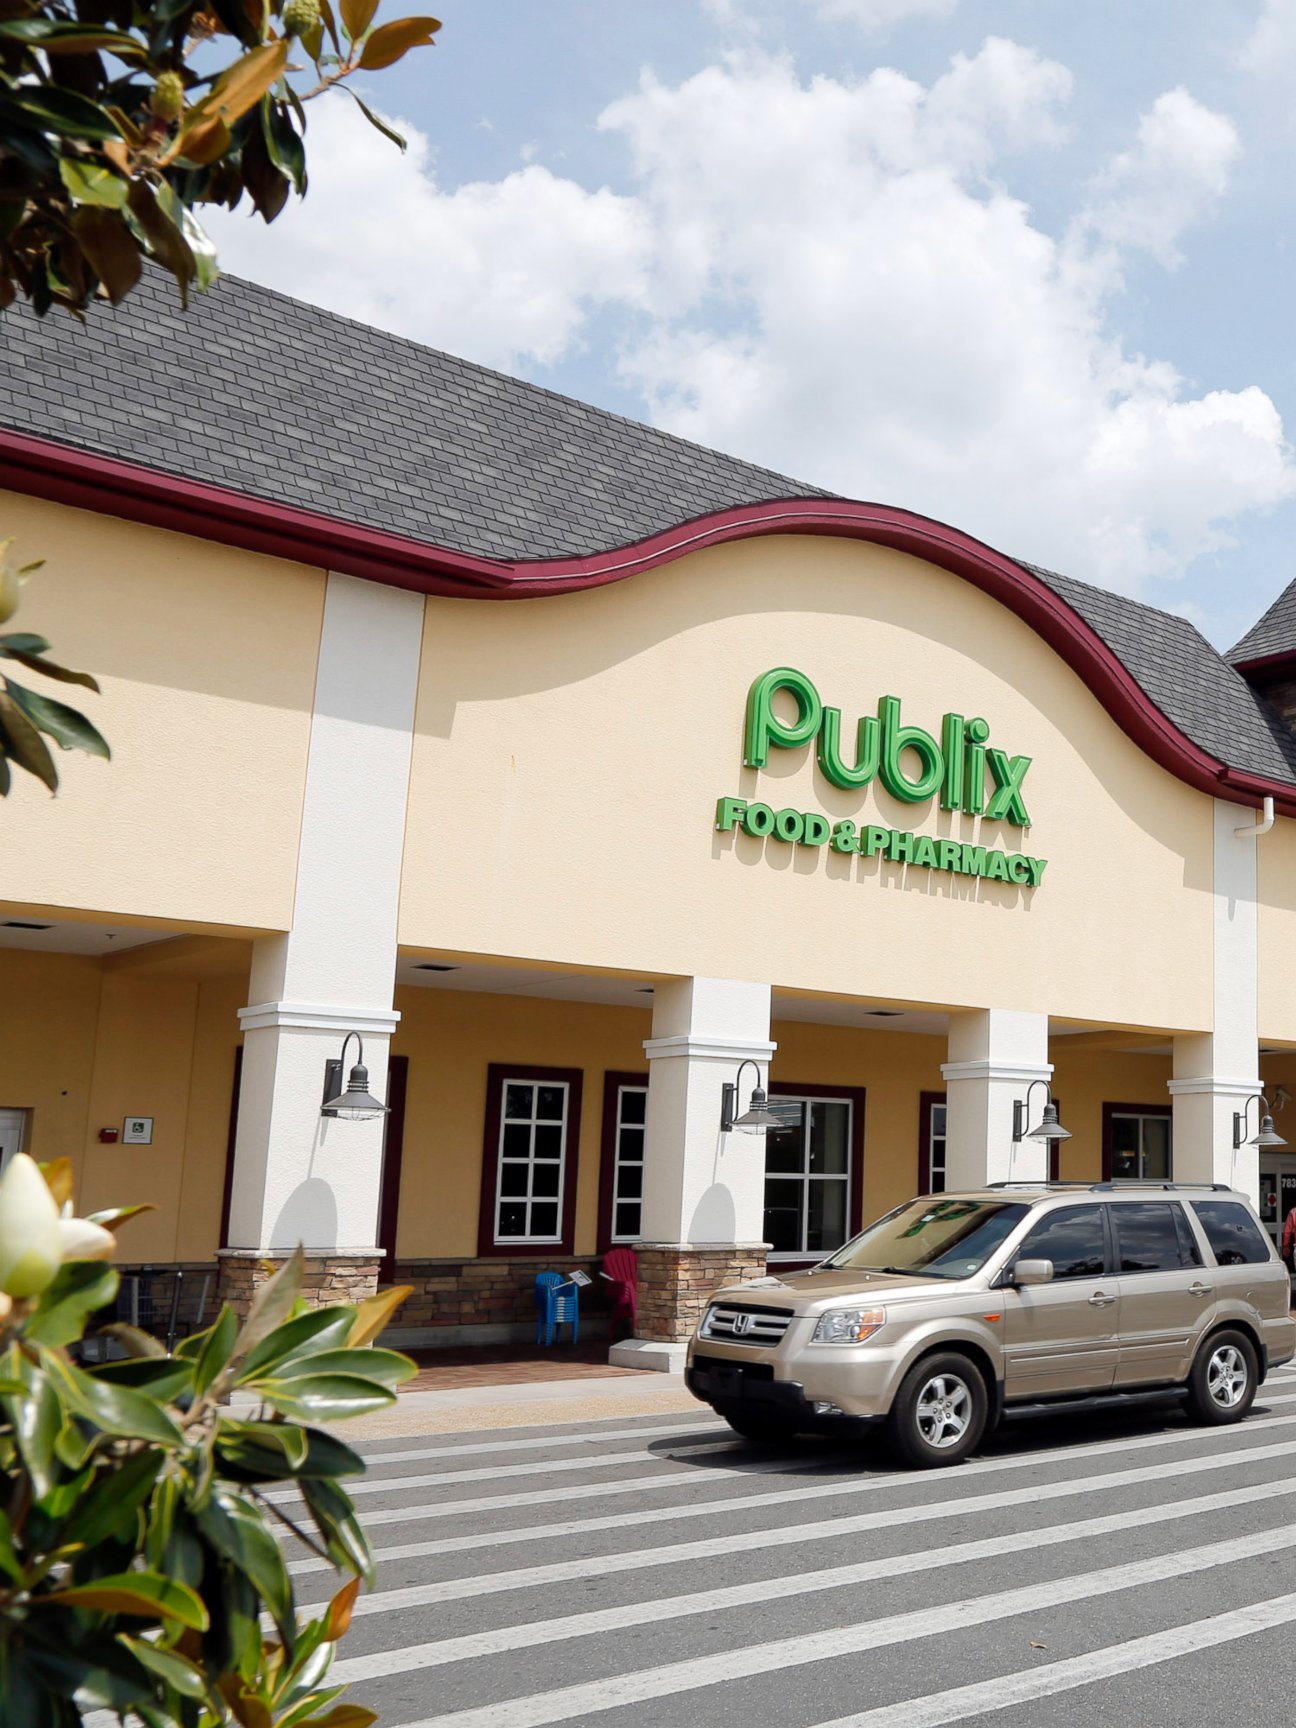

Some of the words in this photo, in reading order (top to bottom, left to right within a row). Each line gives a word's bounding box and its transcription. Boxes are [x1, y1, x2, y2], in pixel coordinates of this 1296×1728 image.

[743, 666, 1033, 827] Publix
[715, 797, 830, 846] FOOD
[830, 819, 861, 854] &
[860, 825, 1048, 887] PHARMACY
